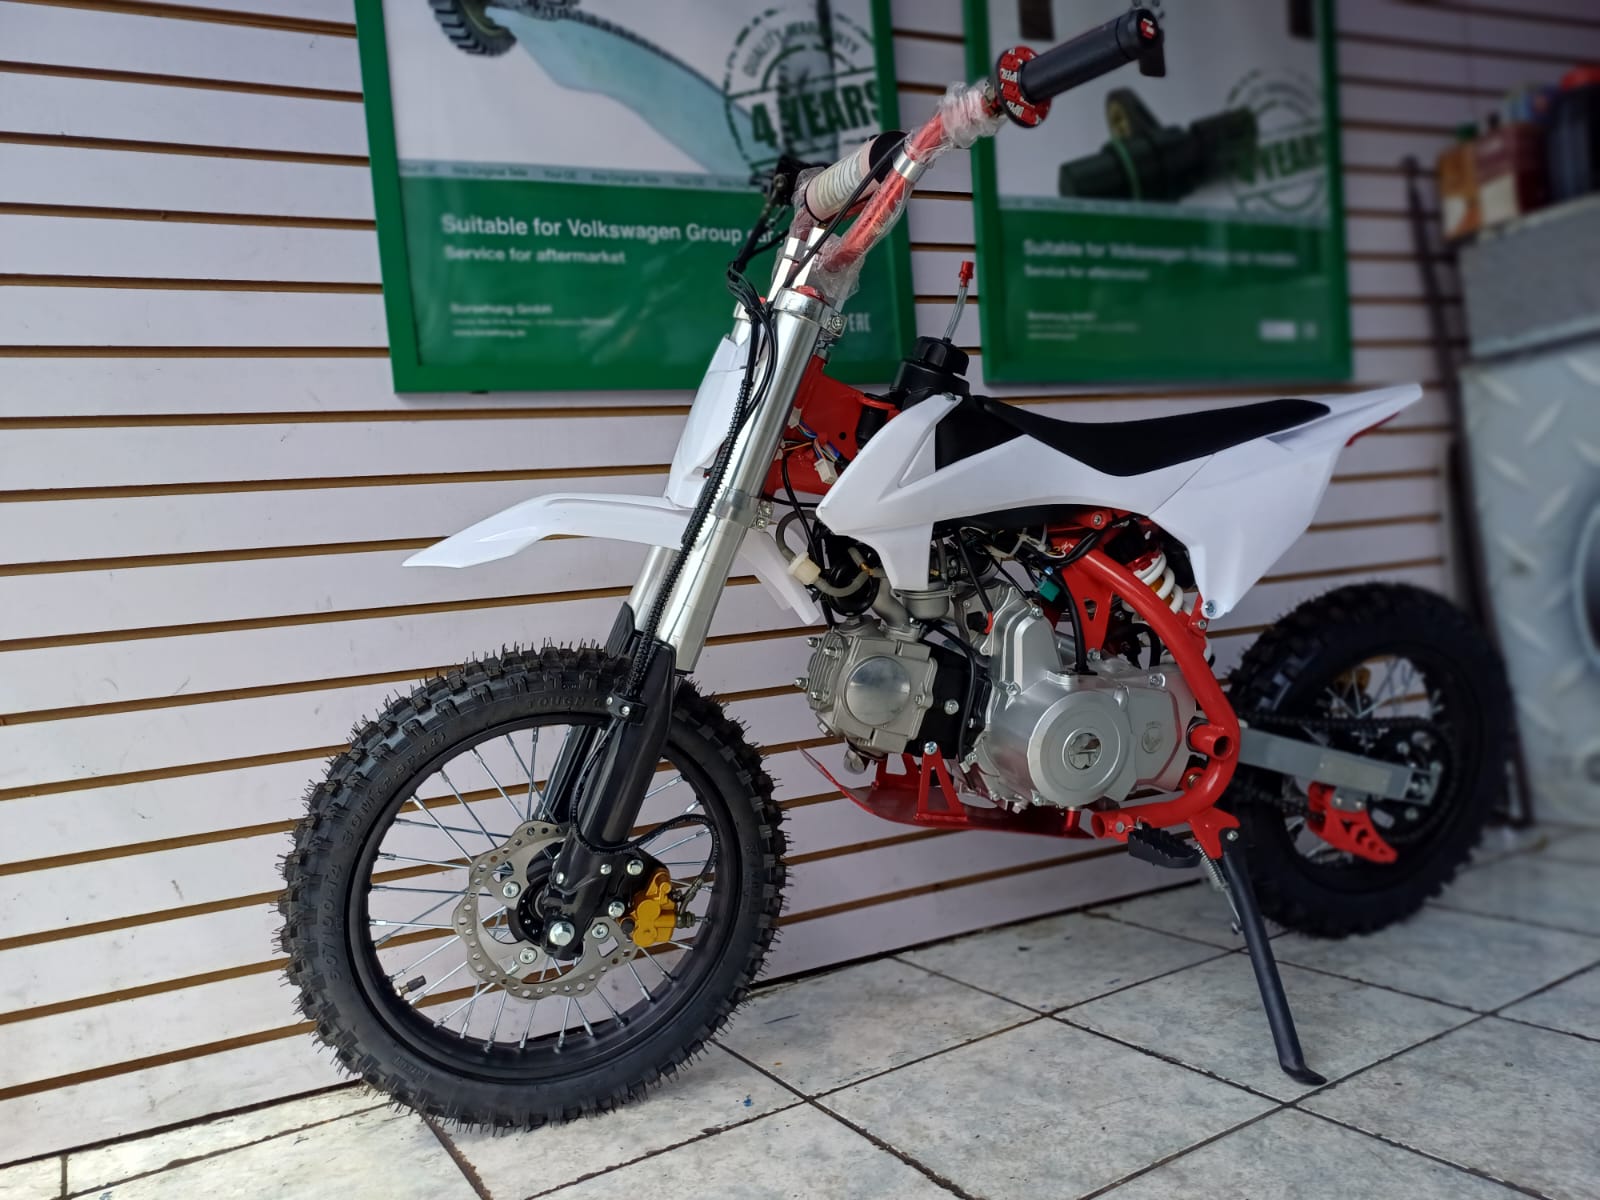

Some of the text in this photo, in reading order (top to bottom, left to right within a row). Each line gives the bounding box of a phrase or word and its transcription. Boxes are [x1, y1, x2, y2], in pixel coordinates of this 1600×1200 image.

[752, 102, 777, 148] 4
[441, 213, 529, 236] Suitable
[533, 218, 561, 237] for
[567, 219, 681, 245] Volkswagen
[685, 223, 743, 246] Group
[444, 245, 627, 265] Service for aftermarket
